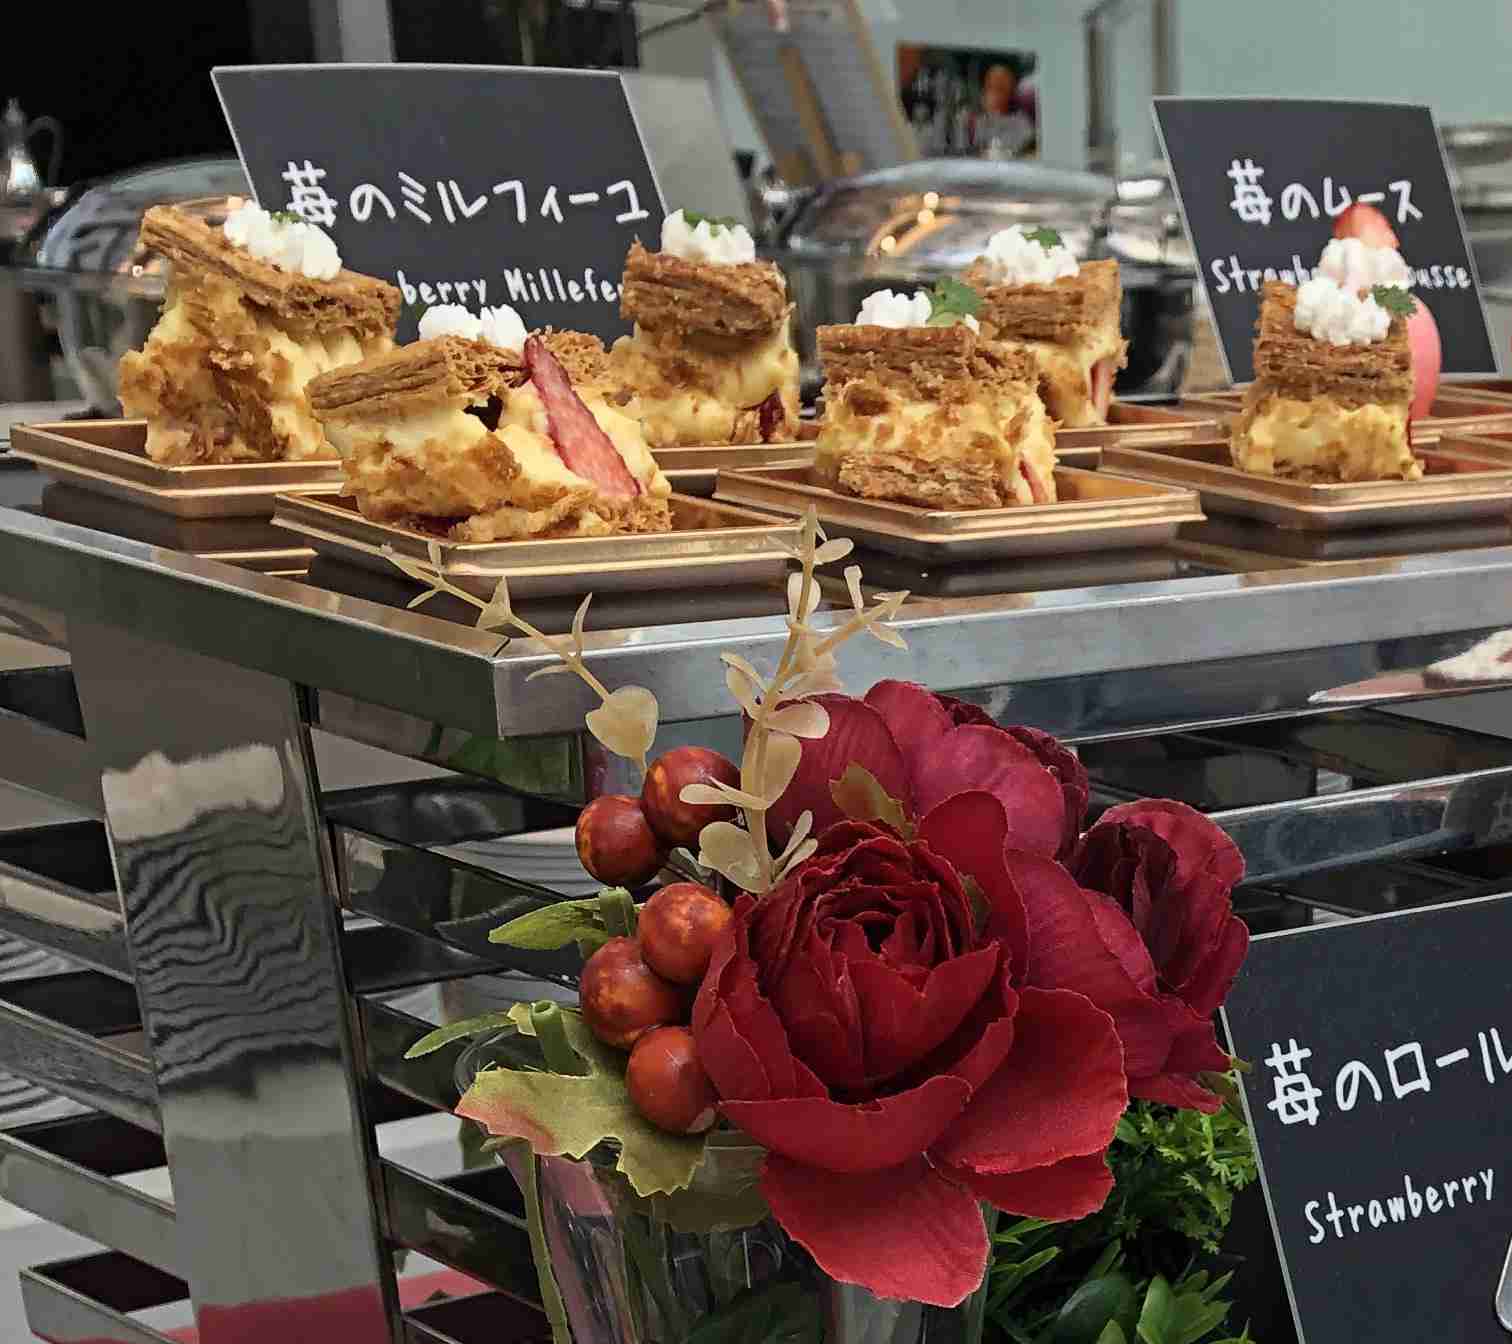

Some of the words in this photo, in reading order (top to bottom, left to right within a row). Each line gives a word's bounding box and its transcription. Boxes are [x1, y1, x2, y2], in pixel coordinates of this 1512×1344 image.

[281, 159, 651, 228] 苺のミルフィーユ
[1226, 157, 1424, 226] 苺のムース
[397, 269, 487, 304] berry
[1303, 1166, 1496, 1246] Strawberry
